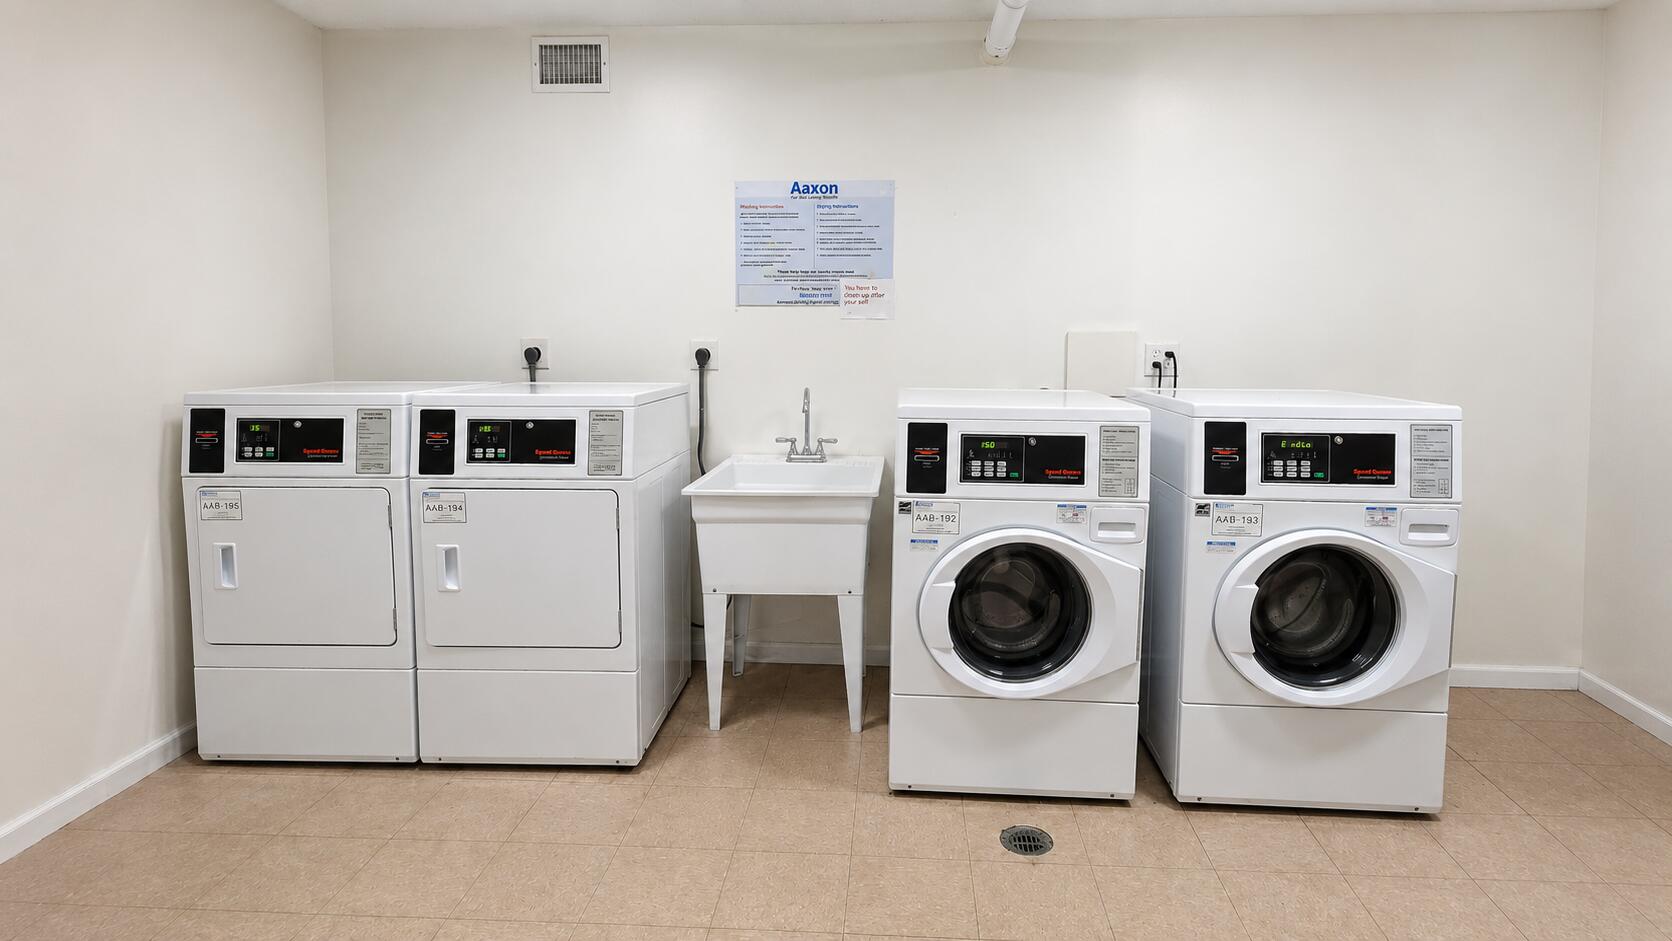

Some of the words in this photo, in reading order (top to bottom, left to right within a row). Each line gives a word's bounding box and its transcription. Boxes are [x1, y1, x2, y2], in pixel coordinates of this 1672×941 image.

[790, 181, 838, 195] Aaxon
[203, 502, 240, 510] AAB-195
[425, 504, 463, 512] AAB-194
[915, 513, 957, 523] AAB-192
[1215, 515, 1259, 525] AAB-193
